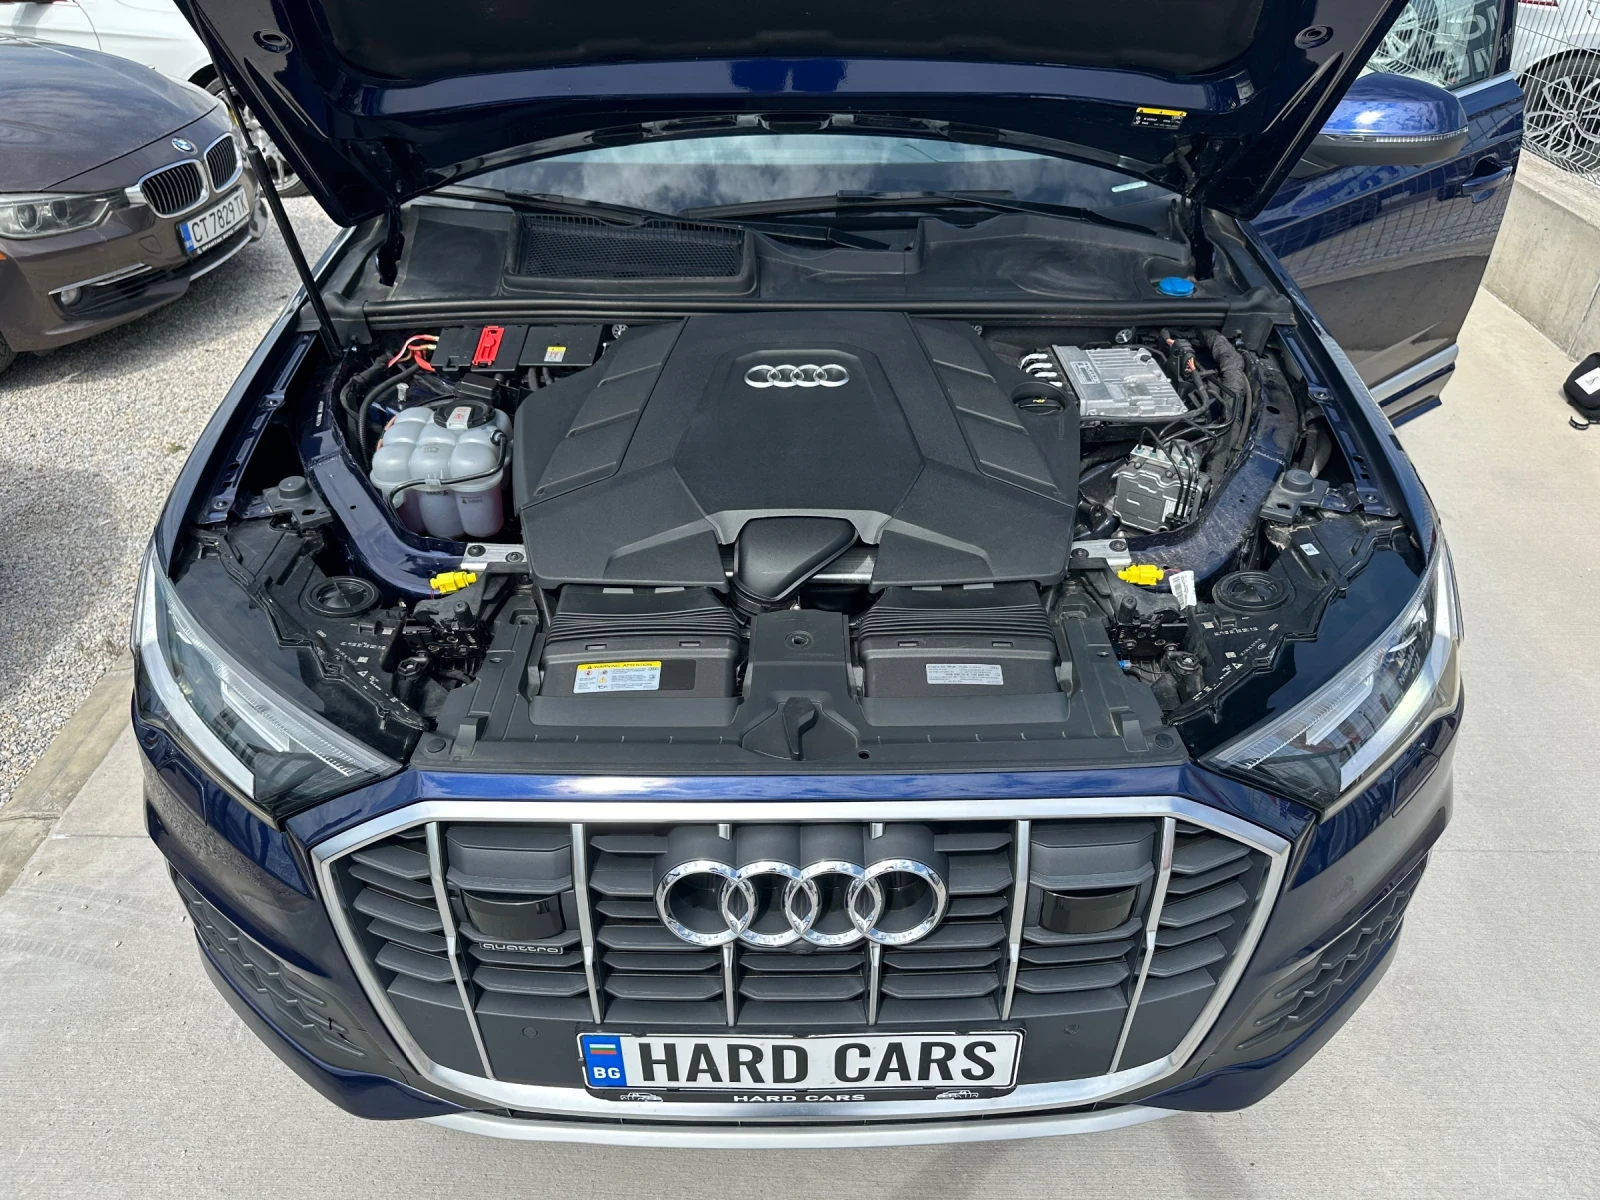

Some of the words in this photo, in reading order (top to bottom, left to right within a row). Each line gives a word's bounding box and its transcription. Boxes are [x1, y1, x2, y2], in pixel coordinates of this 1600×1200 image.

[191, 217, 209, 242] CT
[209, 202, 235, 234] 7829
[233, 191, 248, 215] TK
[483, 943, 559, 953] quattro
[593, 1066, 621, 1079] BG
[638, 1042, 809, 1084] HARD
[834, 1041, 997, 1083] CARS
[805, 1094, 866, 1102] CARS
